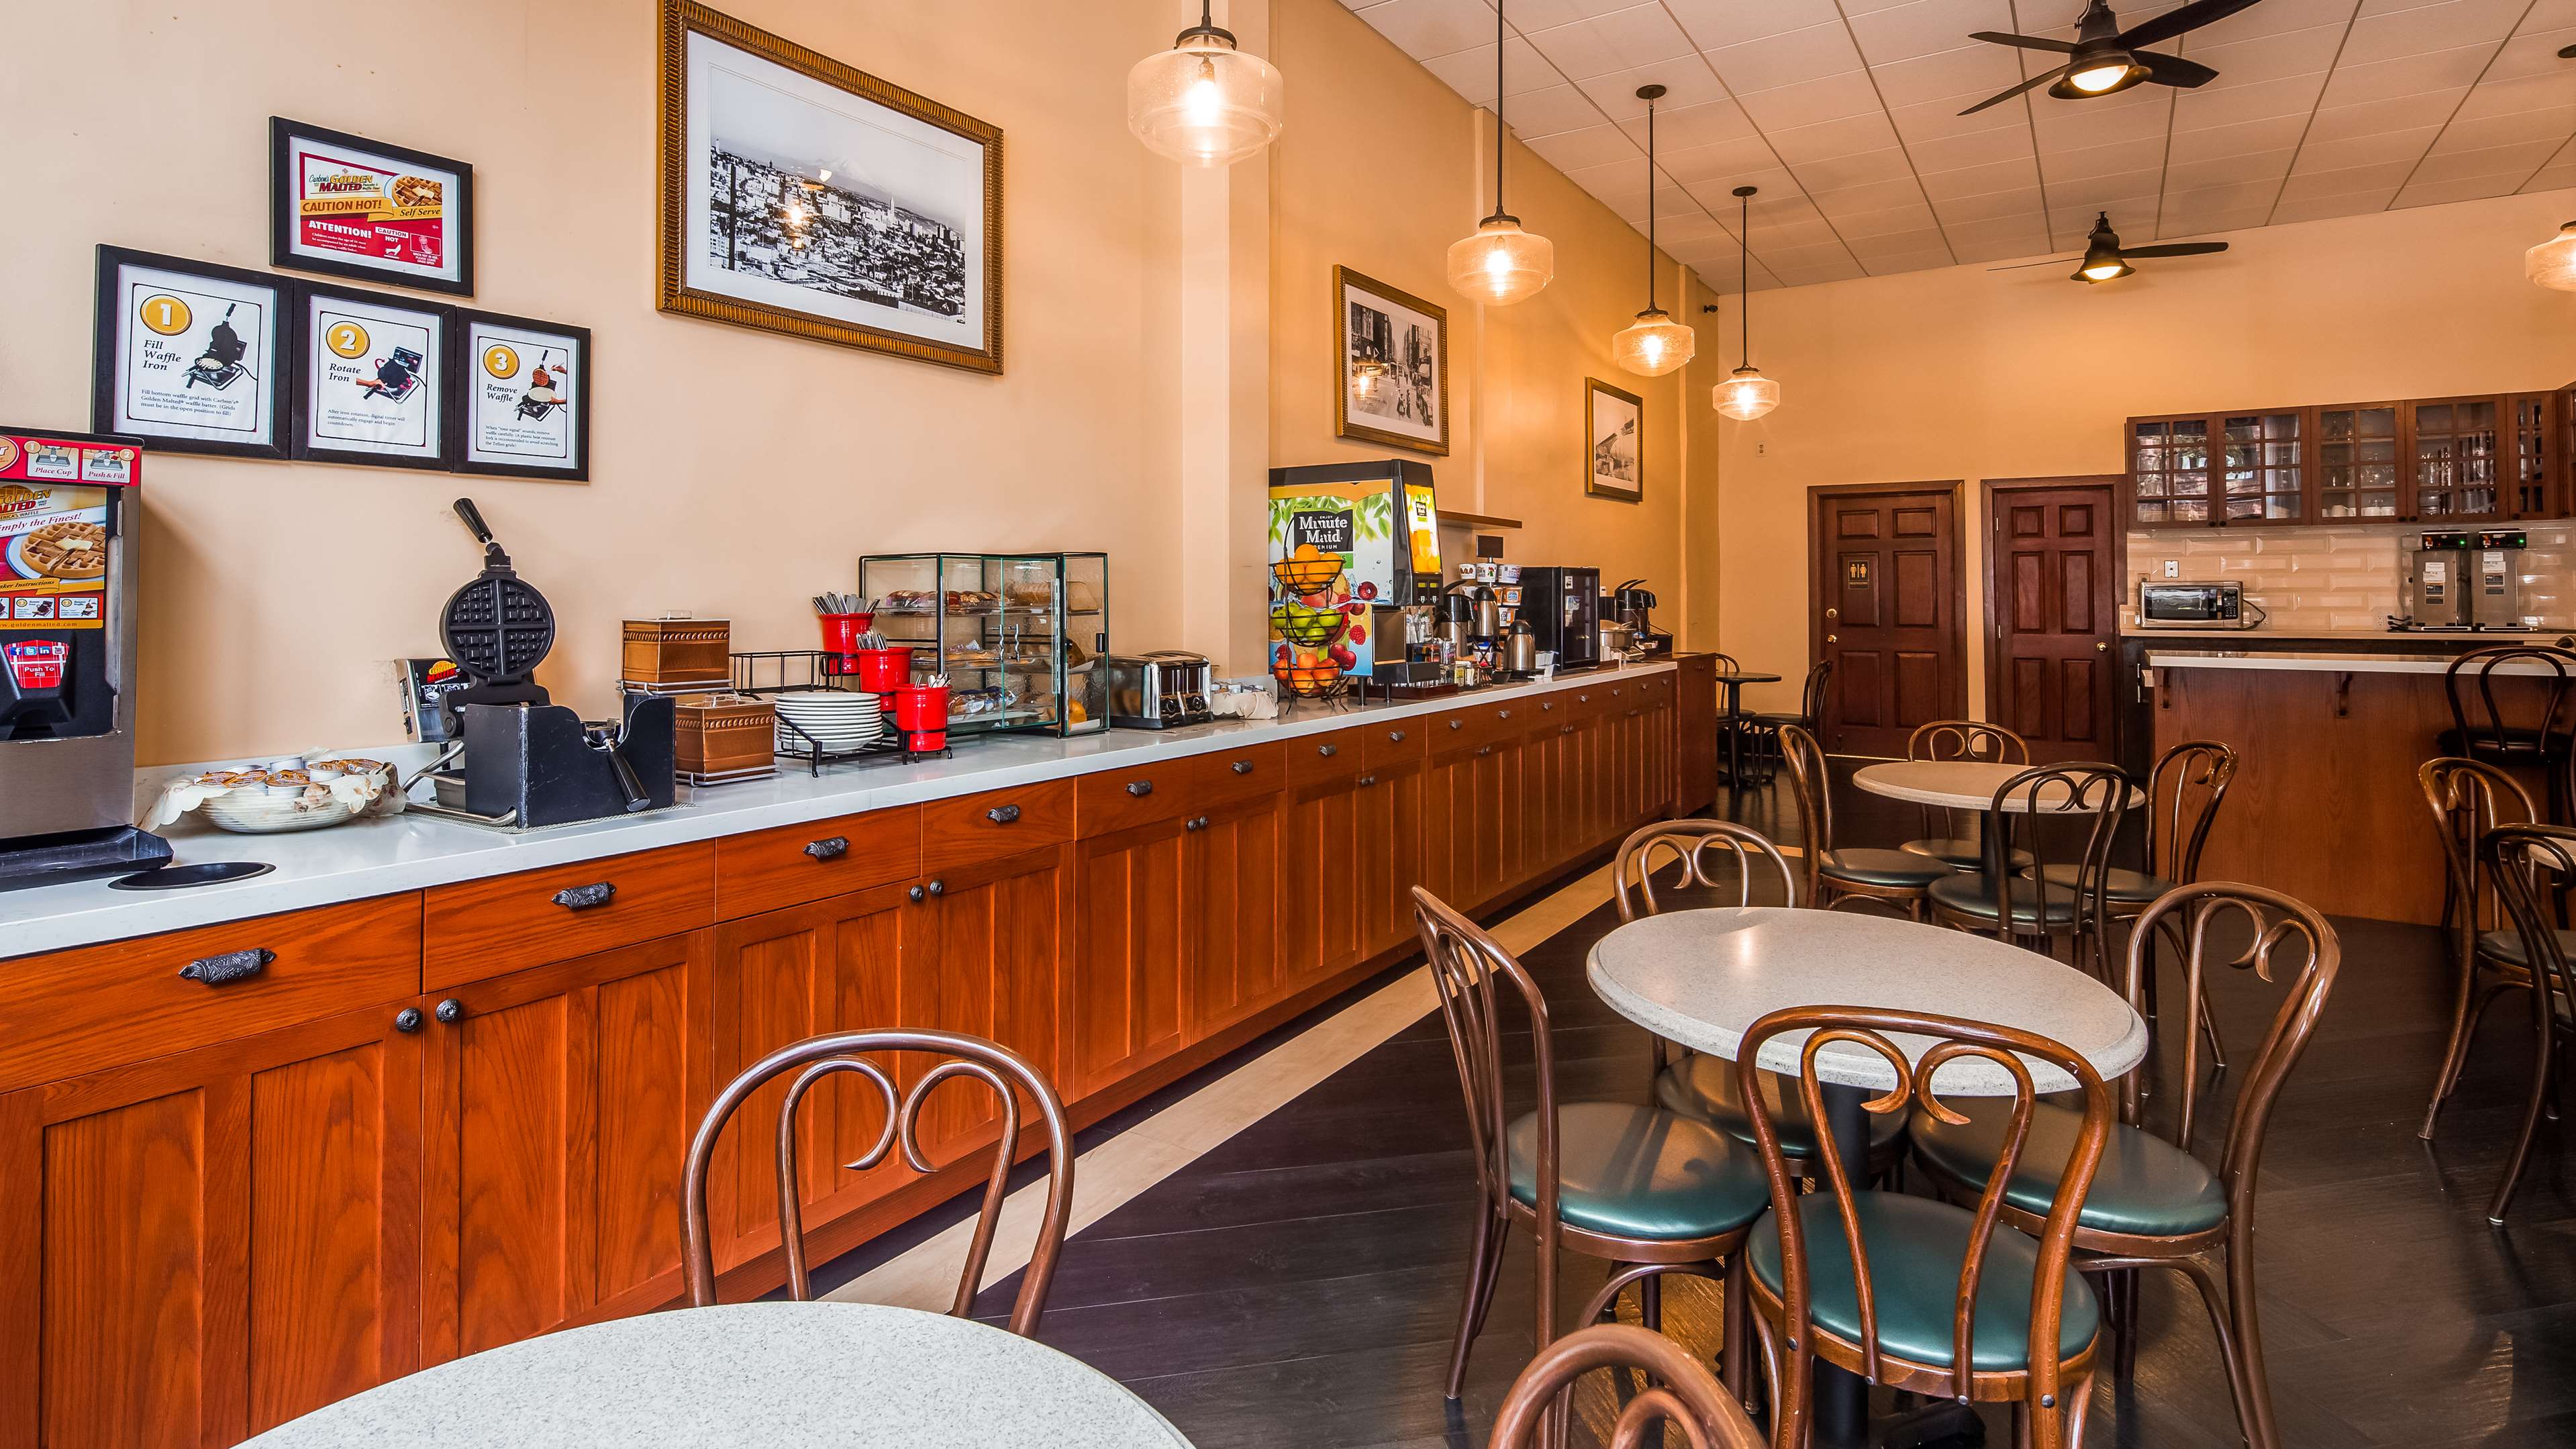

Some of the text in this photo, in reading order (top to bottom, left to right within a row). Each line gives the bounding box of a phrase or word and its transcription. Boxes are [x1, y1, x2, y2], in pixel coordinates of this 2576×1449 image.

[330, 174, 373, 184] GOLDEN
[319, 183, 362, 192] MALTED
[303, 200, 382, 212] CAUTION HOT!
[399, 209, 417, 217] Self
[308, 220, 372, 239] ATTENTION!
[377, 228, 407, 238] CAUTION
[160, 303, 172, 326] 1
[144, 340, 164, 350] Fill
[340, 330, 356, 351] 2
[144, 350, 182, 363] Waffle
[494, 352, 508, 371] 3
[142, 360, 168, 370] Iron
[329, 363, 361, 374] Rotate
[328, 372, 350, 382] Iron
[487, 384, 517, 394] Remove
[487, 393, 513, 403] Waffle
[30, 517, 46, 527] the
[48, 512, 83, 524] Finest!
[1299, 516, 1348, 530] Minute
